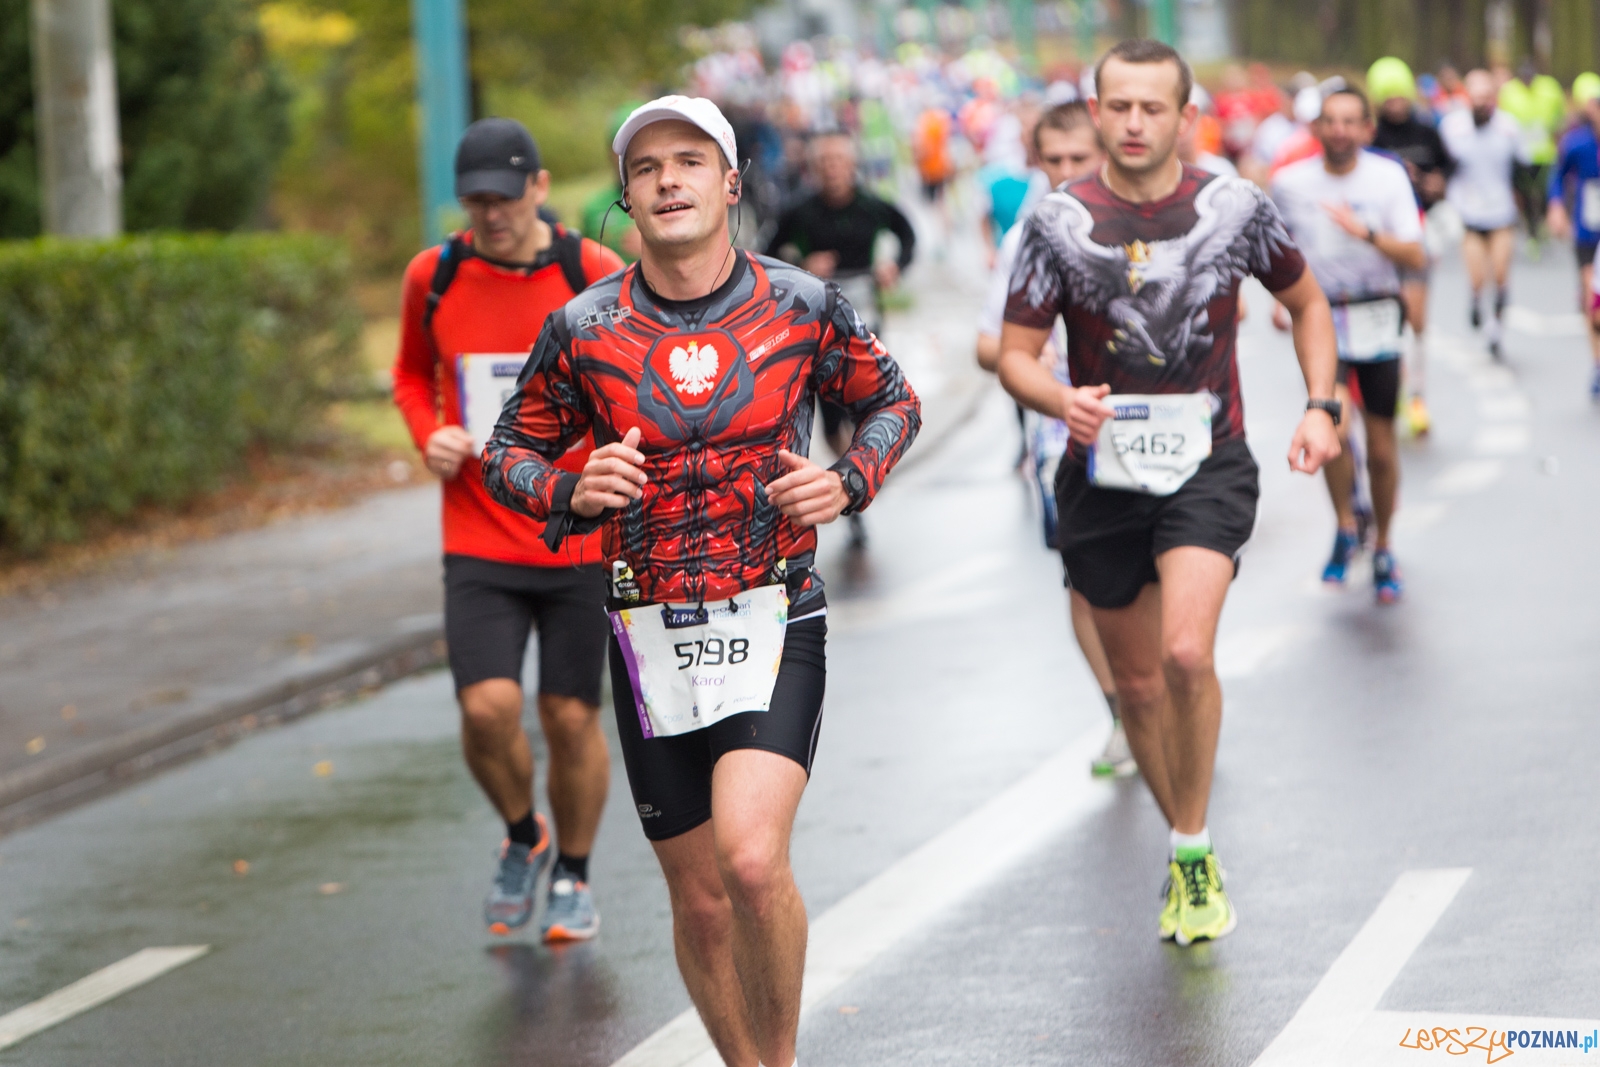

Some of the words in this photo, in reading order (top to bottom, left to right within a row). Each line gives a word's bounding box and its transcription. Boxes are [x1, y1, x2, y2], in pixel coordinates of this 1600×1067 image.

[1111, 433, 1186, 455] 5462
[673, 637, 750, 670] 5798
[691, 675, 726, 687] Karol
